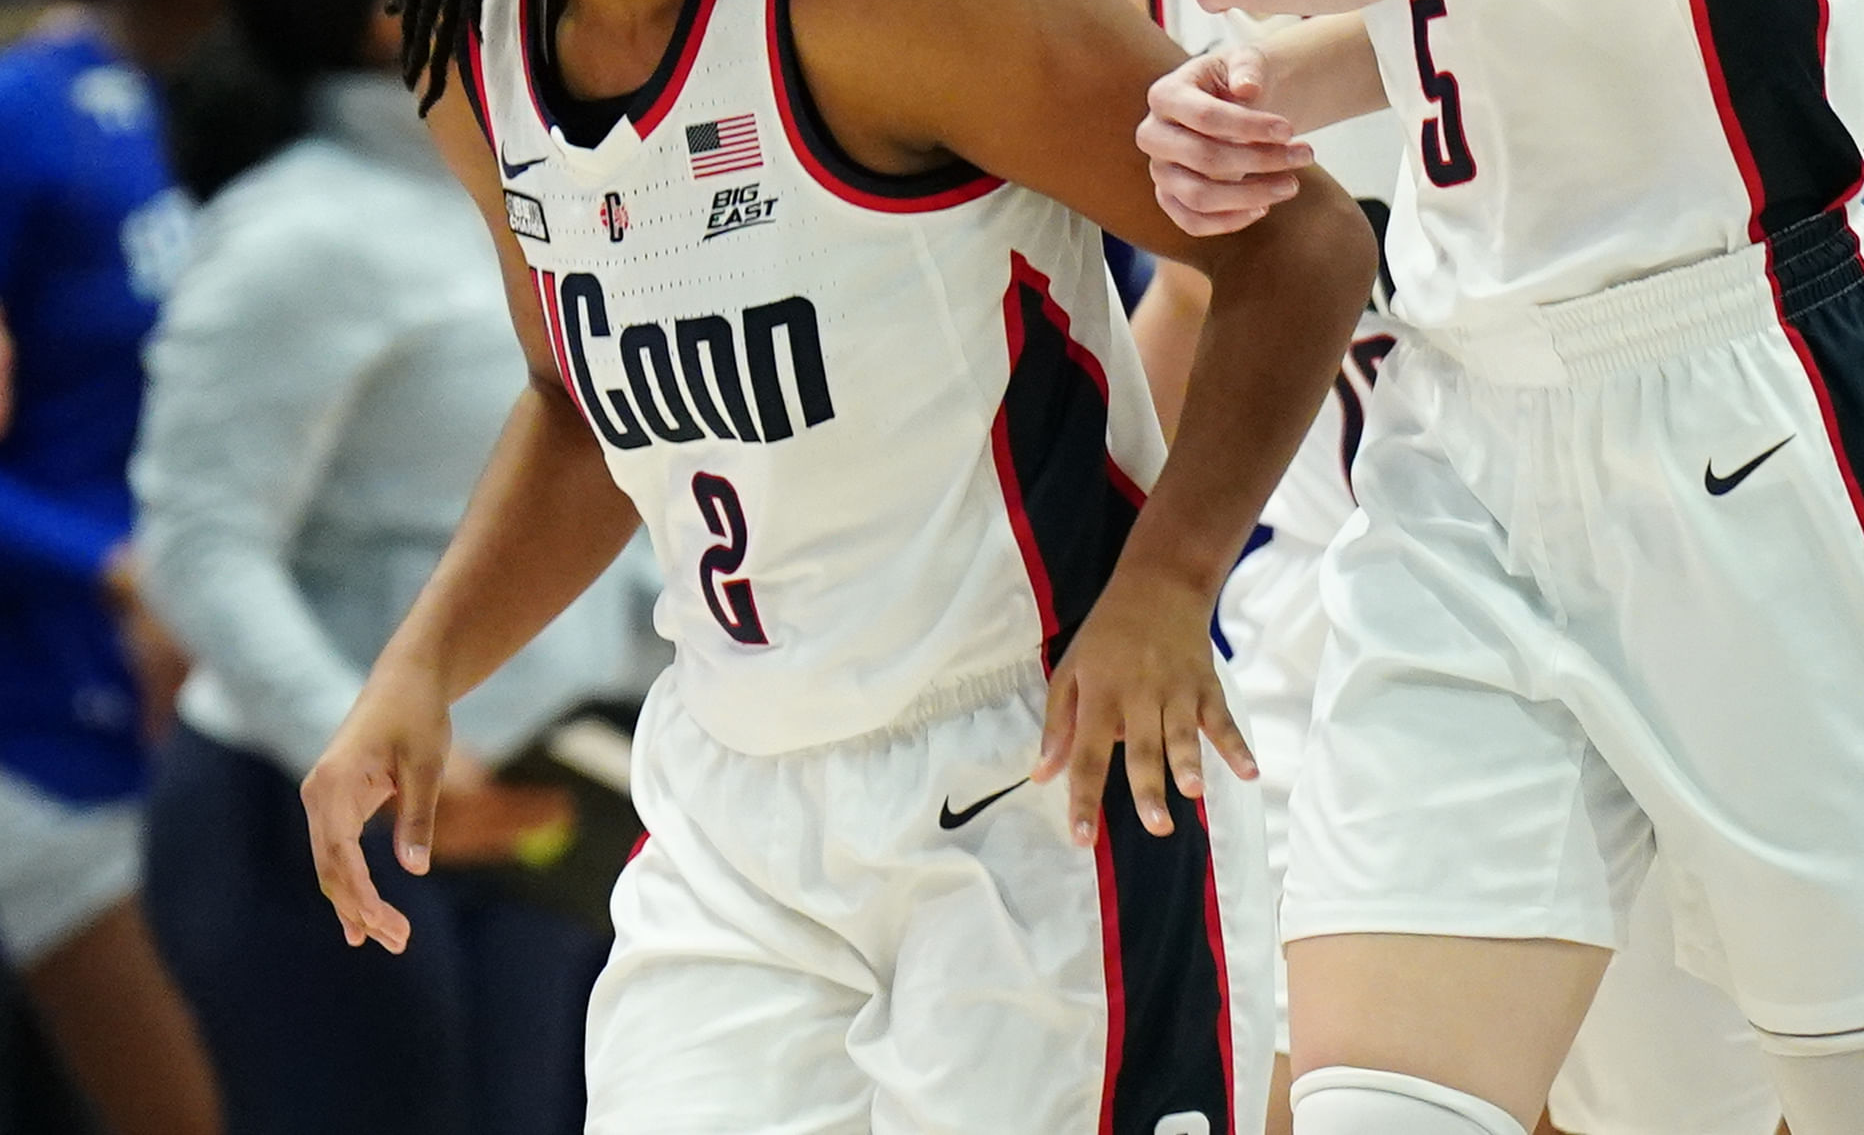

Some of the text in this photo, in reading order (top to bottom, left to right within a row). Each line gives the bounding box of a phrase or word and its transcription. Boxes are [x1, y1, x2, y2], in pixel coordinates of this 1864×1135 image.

[712, 183, 760, 209] BIG
[707, 198, 778, 229] EAST
[691, 471, 769, 645] 2
